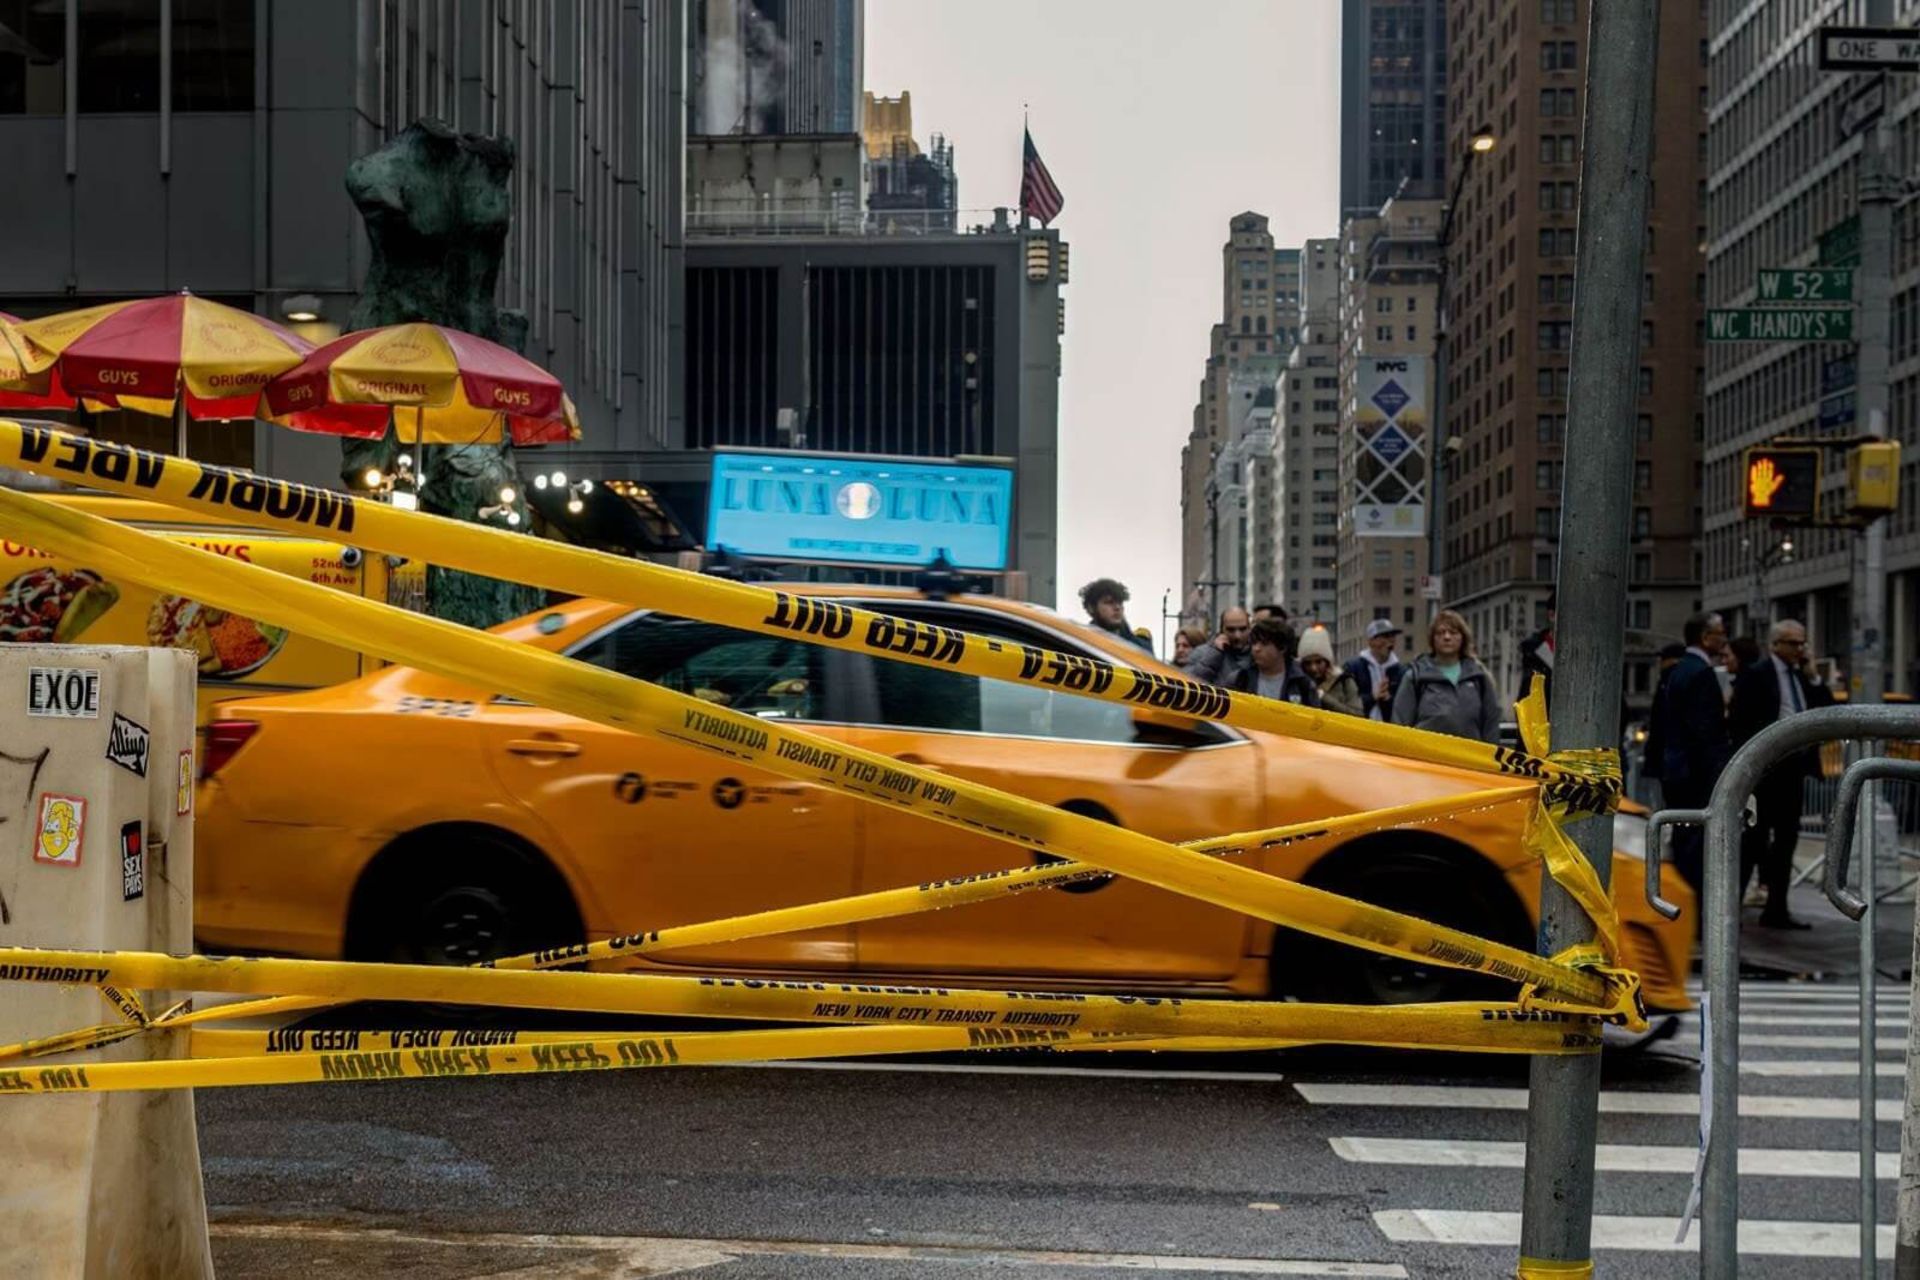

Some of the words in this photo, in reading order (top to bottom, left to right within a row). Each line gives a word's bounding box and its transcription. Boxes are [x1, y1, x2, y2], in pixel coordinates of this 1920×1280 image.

[1839, 41, 1877, 59] ONE
[1760, 272, 1779, 299] W
[1792, 273, 1824, 299] 52
[1834, 273, 1848, 286] ST
[1711, 312, 1740, 338] WC
[1750, 312, 1827, 338] HANDYS
[98, 370, 140, 385] GUYS
[1376, 361, 1407, 372] NYC
[357, 380, 429, 396] ORIGINAL
[494, 387, 531, 406] GUYS
[19, 424, 167, 489] AREA
[763, 592, 853, 639] OUT
[864, 614, 967, 664] KEEP
[1018, 646, 1114, 694] AREA
[29, 672, 98, 713] EXOE
[1122, 667, 1231, 721] WORK
[124, 857, 141, 877] SEX
[124, 875, 143, 897] PAYS
[0, 964, 110, 983] AUTHORITY
[813, 1002, 852, 1017] NEW
[854, 1005, 893, 1020] YORK
[899, 1007, 932, 1021] CITY
[936, 1009, 998, 1025] TRANSIT
[1002, 1011, 1080, 1027] AUTHORITY
[266, 1029, 305, 1053] OUT
[311, 1028, 360, 1051] KEEP
